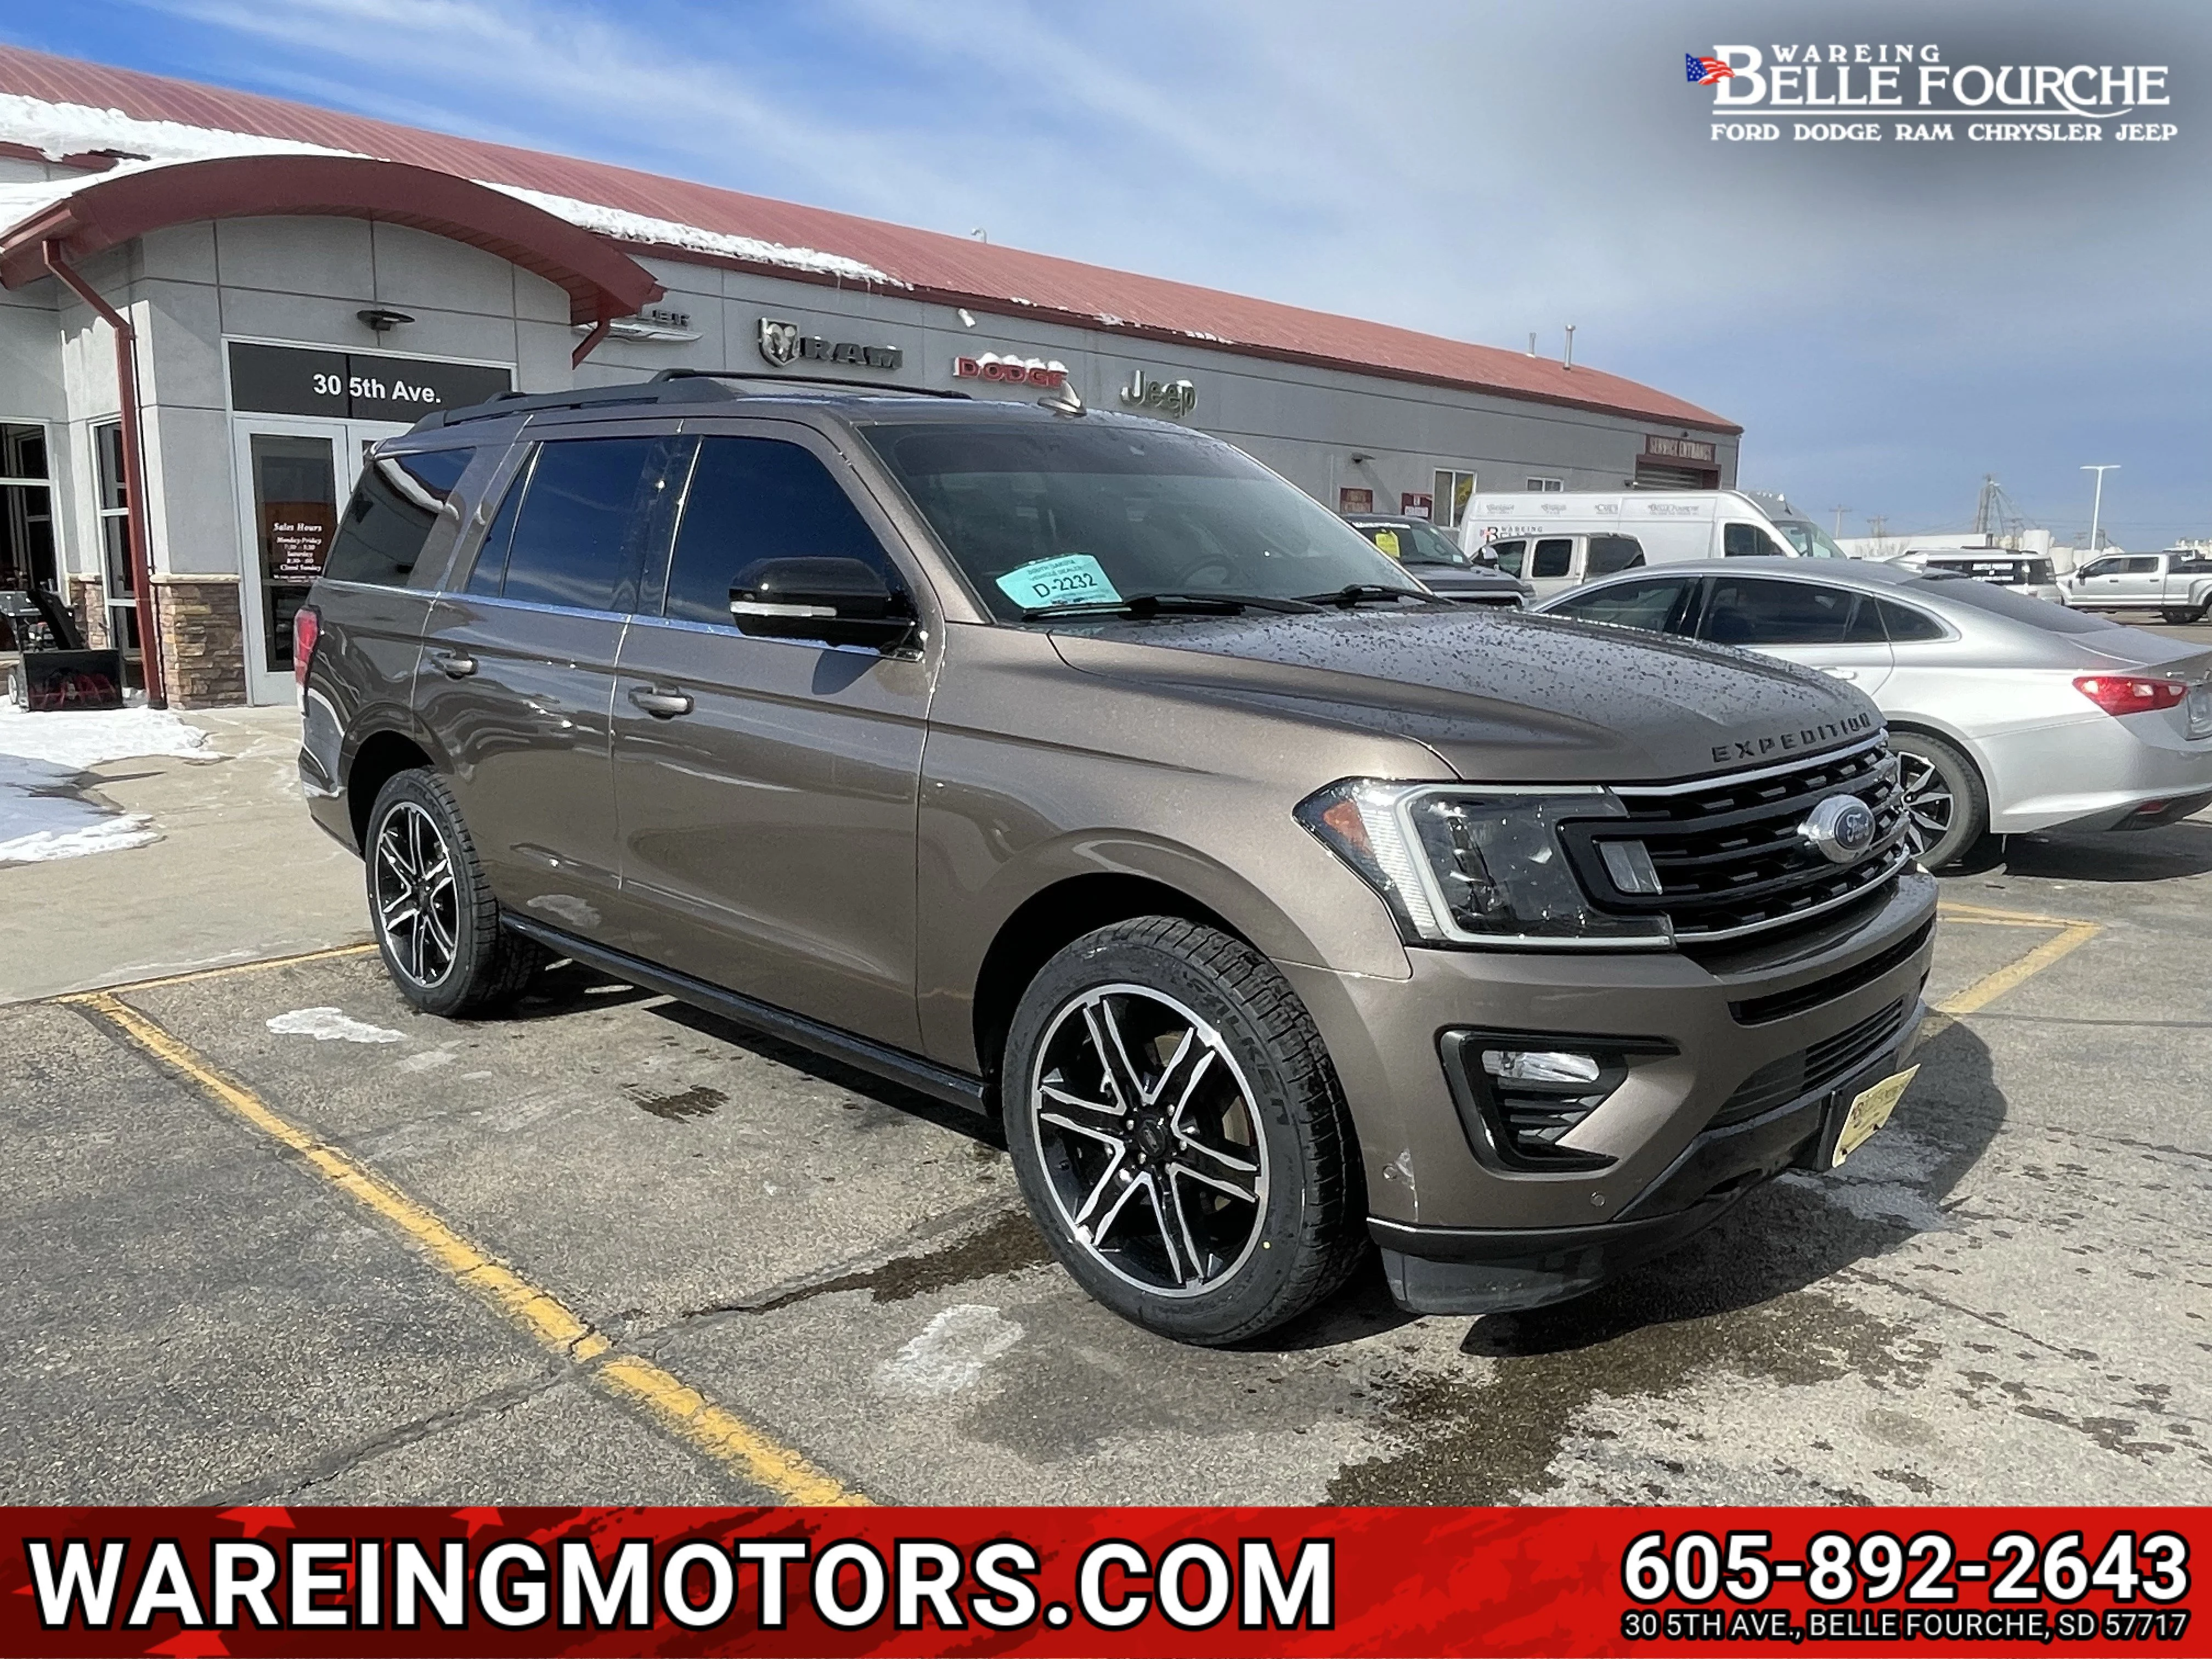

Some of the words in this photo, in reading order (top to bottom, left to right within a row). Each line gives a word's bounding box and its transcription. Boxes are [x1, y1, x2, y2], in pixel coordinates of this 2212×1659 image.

[800, 336, 903, 369] RAM
[952, 356, 1068, 388] DODGE
[313, 373, 342, 396] 30
[349, 376, 386, 399] 5th
[391, 380, 442, 404] Ave.
[1120, 369, 1198, 419] Jeep
[1032, 573, 1098, 598] D-2232
[1711, 713, 1871, 763] EXPEDITION
